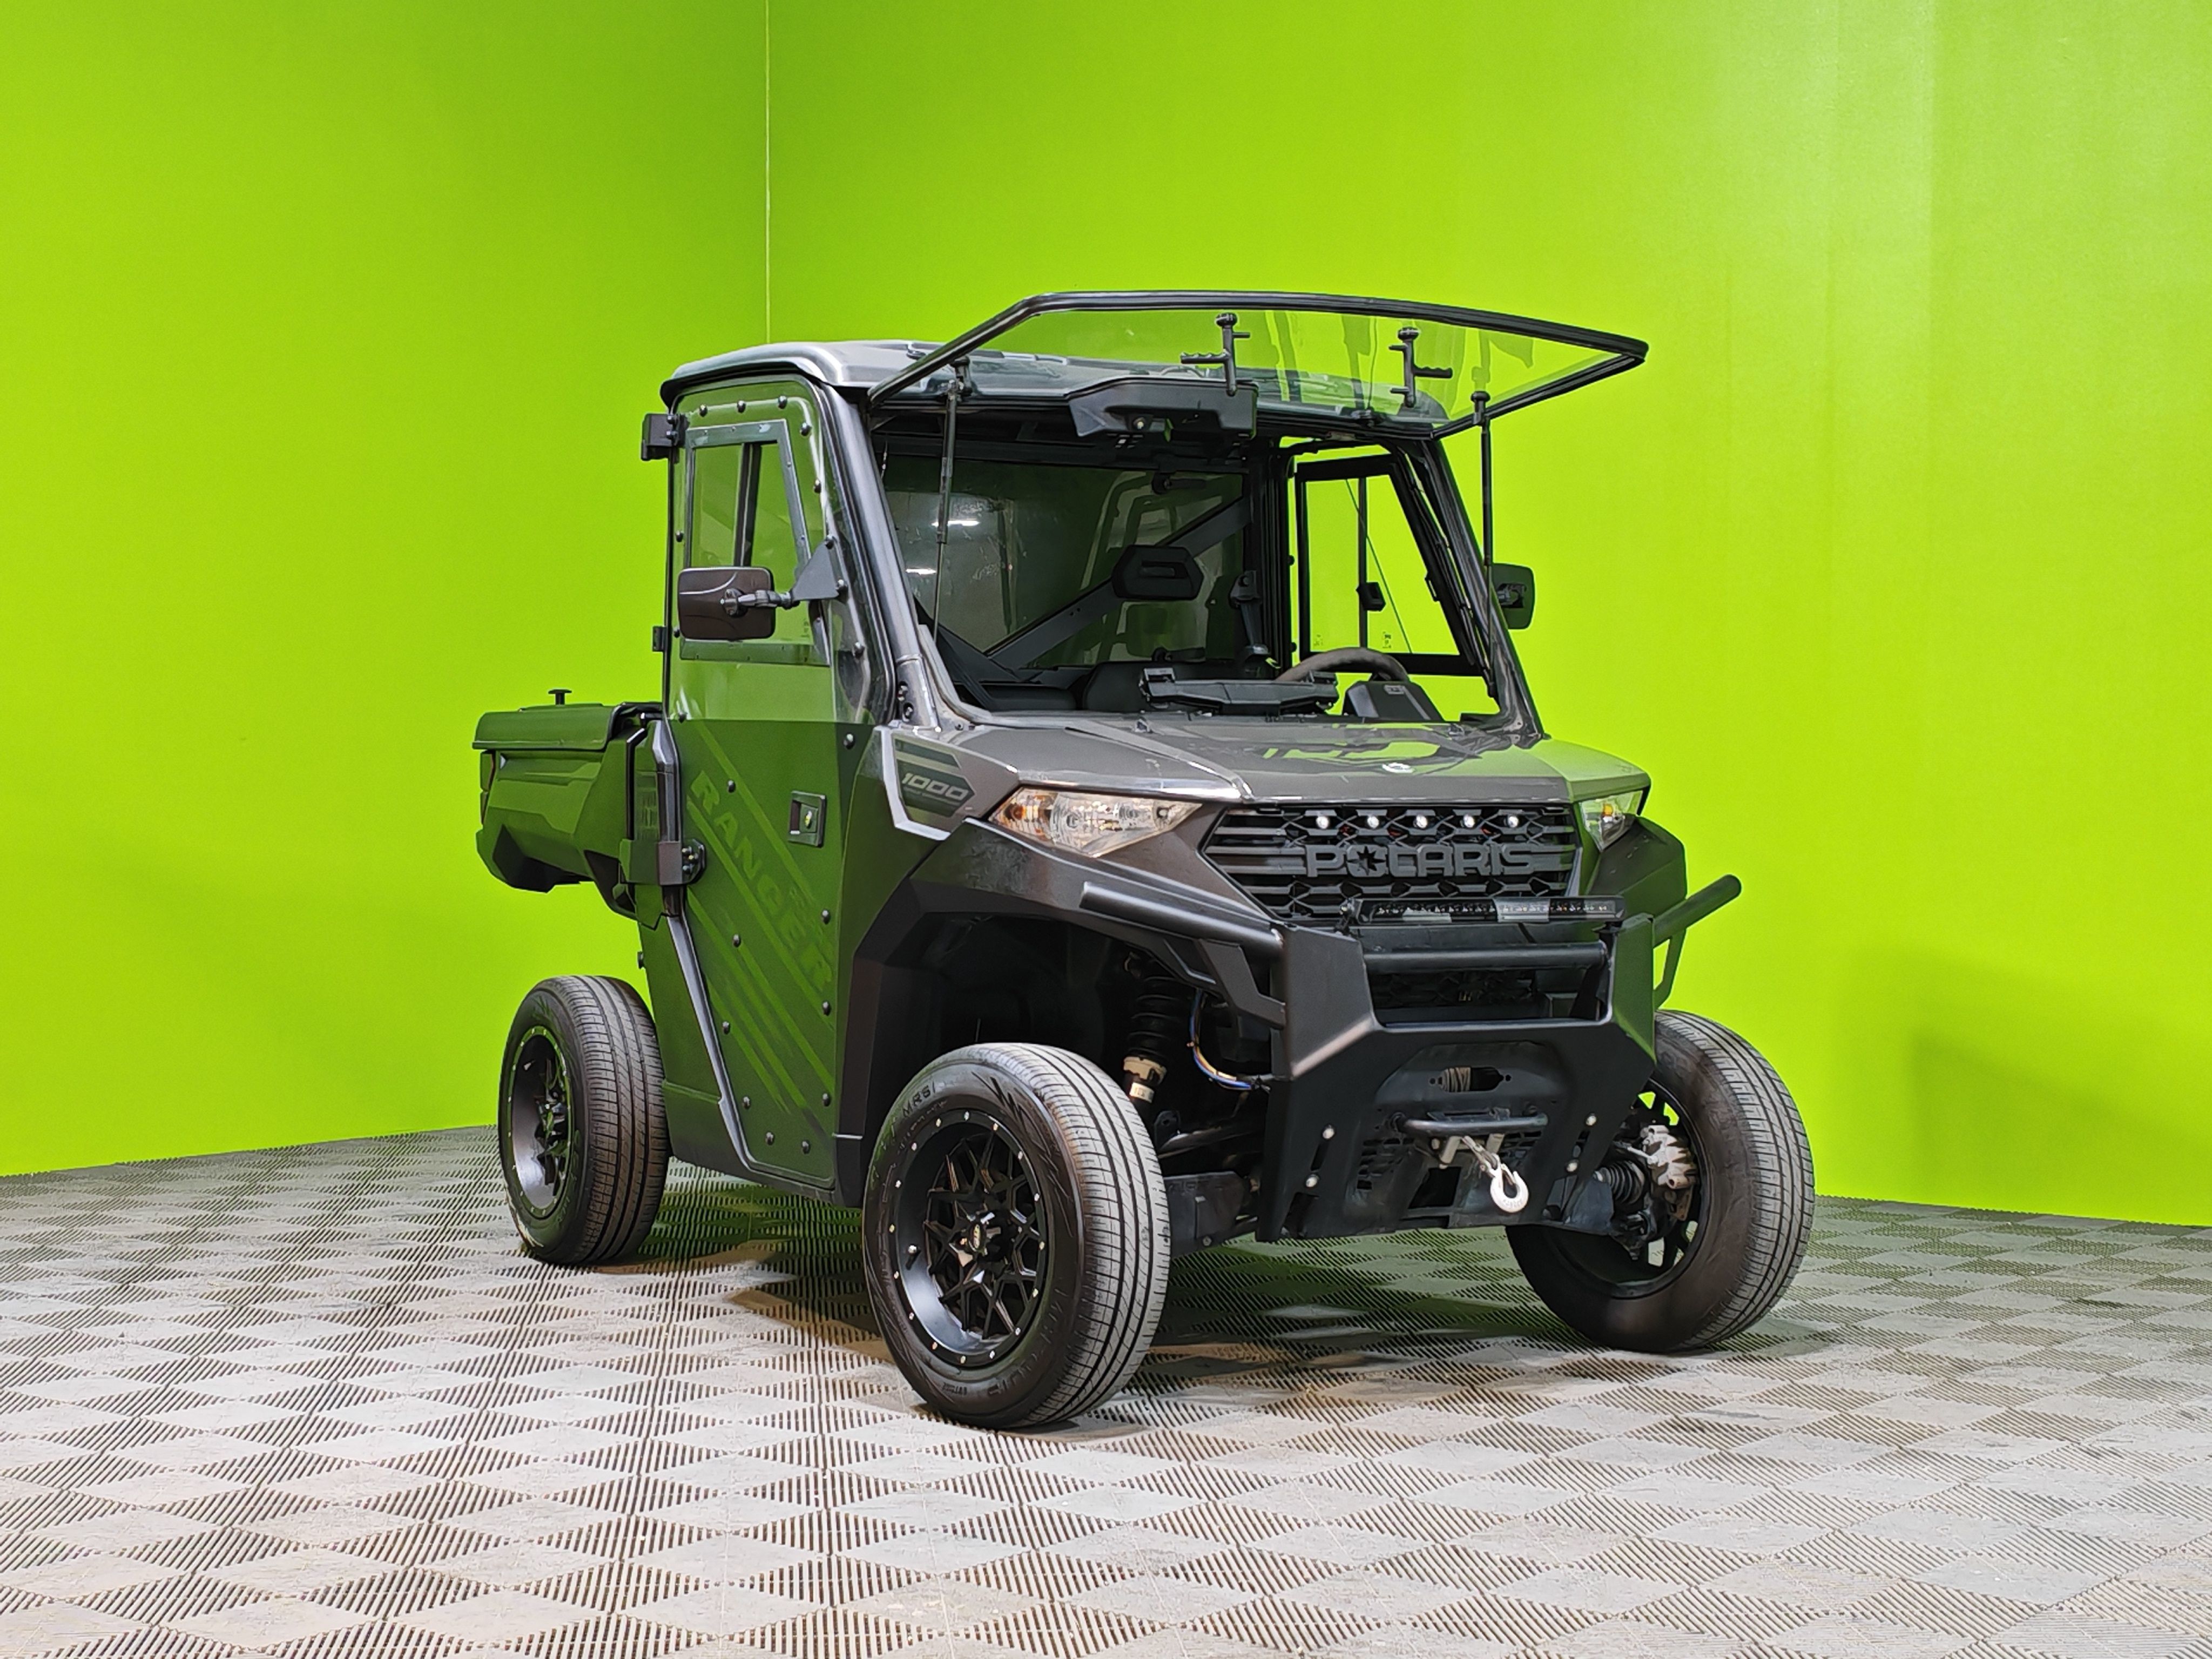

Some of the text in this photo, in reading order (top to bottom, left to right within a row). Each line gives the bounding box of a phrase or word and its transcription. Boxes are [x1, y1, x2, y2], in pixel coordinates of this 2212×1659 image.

[901, 772, 969, 801] 1000
[1306, 843, 1535, 878] POLARIS
[690, 770, 833, 993] RANGER
